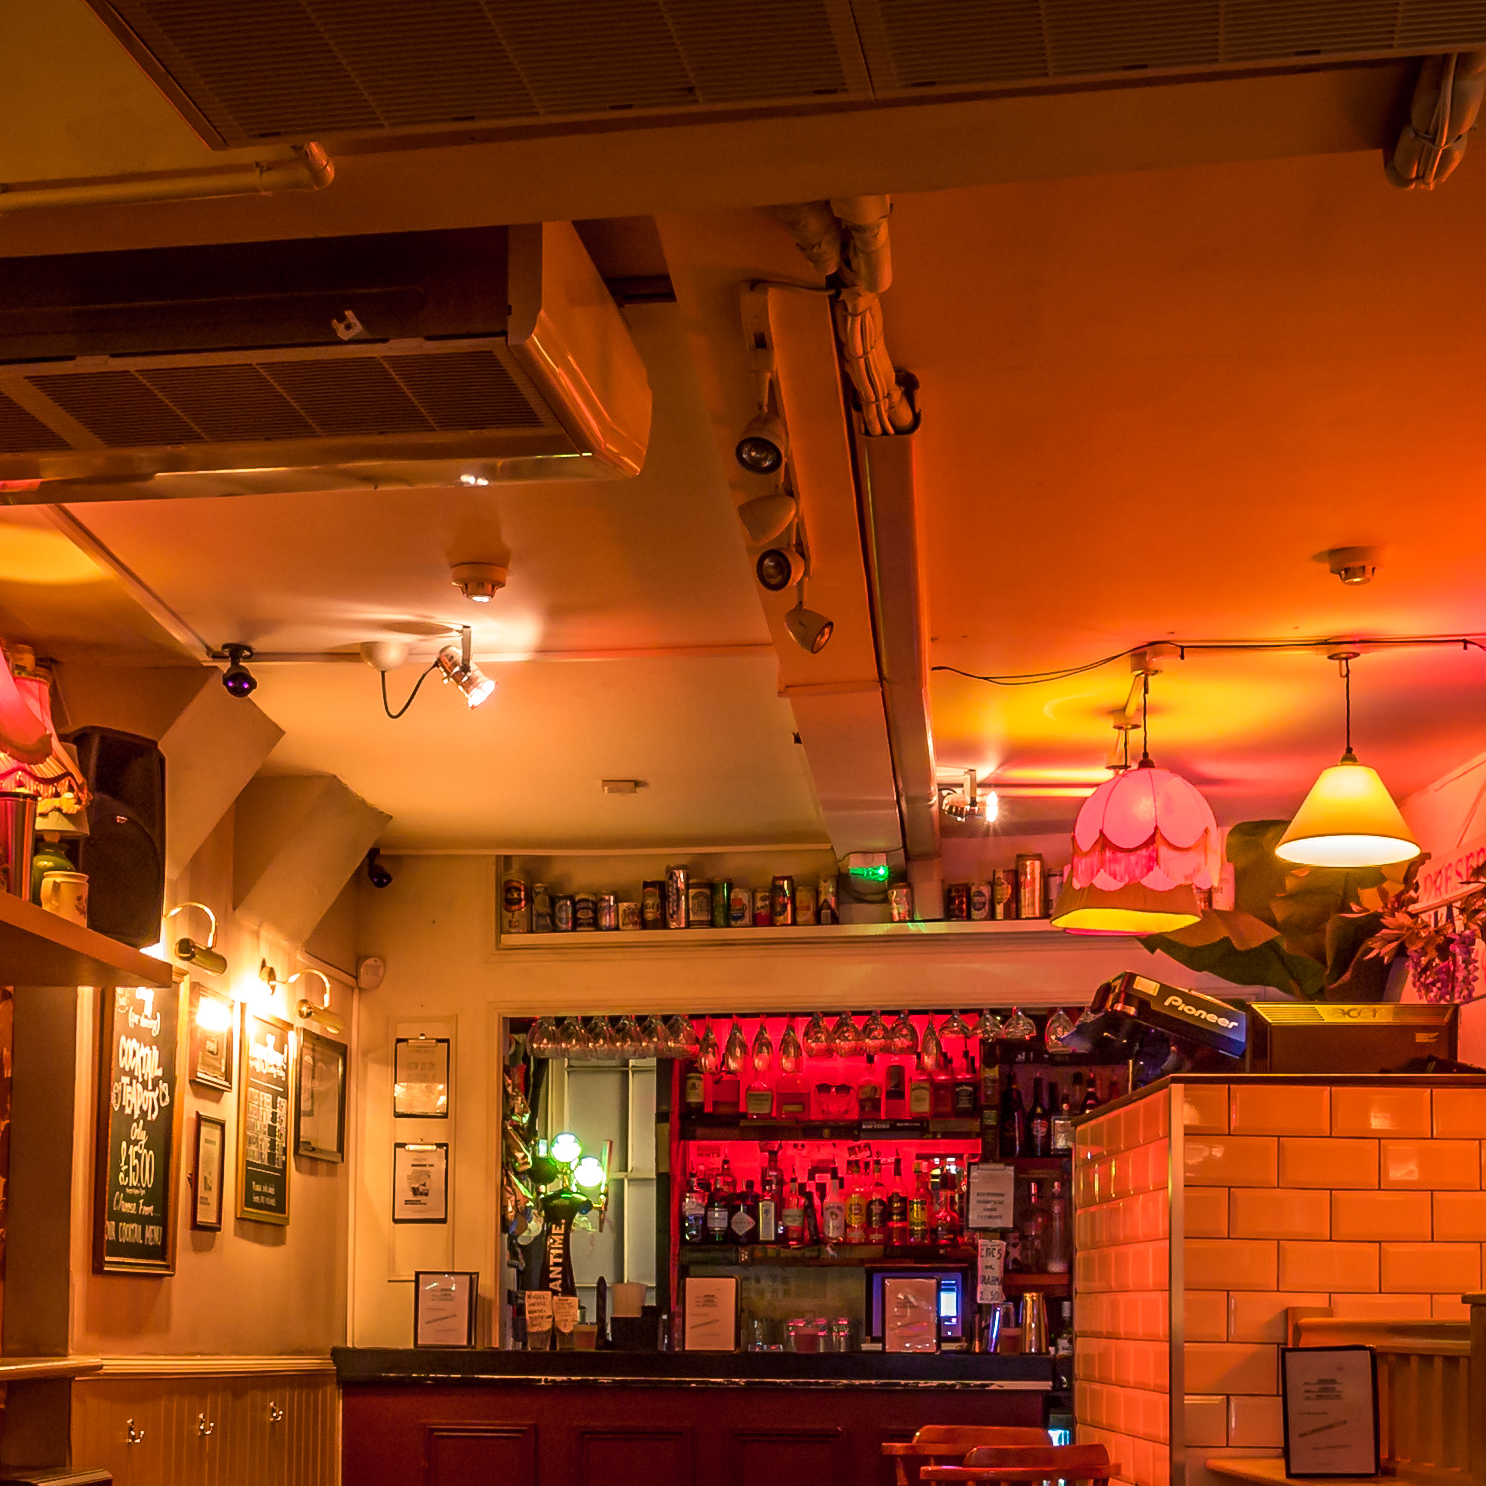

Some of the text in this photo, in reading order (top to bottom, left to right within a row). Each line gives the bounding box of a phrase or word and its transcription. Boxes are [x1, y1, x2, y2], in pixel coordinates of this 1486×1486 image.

[1164, 995, 1238, 1030] Pioneer
[1329, 1007, 1380, 1020] acer
[118, 1035, 163, 1090] COCKTAIL
[120, 1075, 159, 1120] TEAPOTS
[118, 1141, 155, 1188] £15.00
[548, 1219, 566, 1297] ANTIME.
